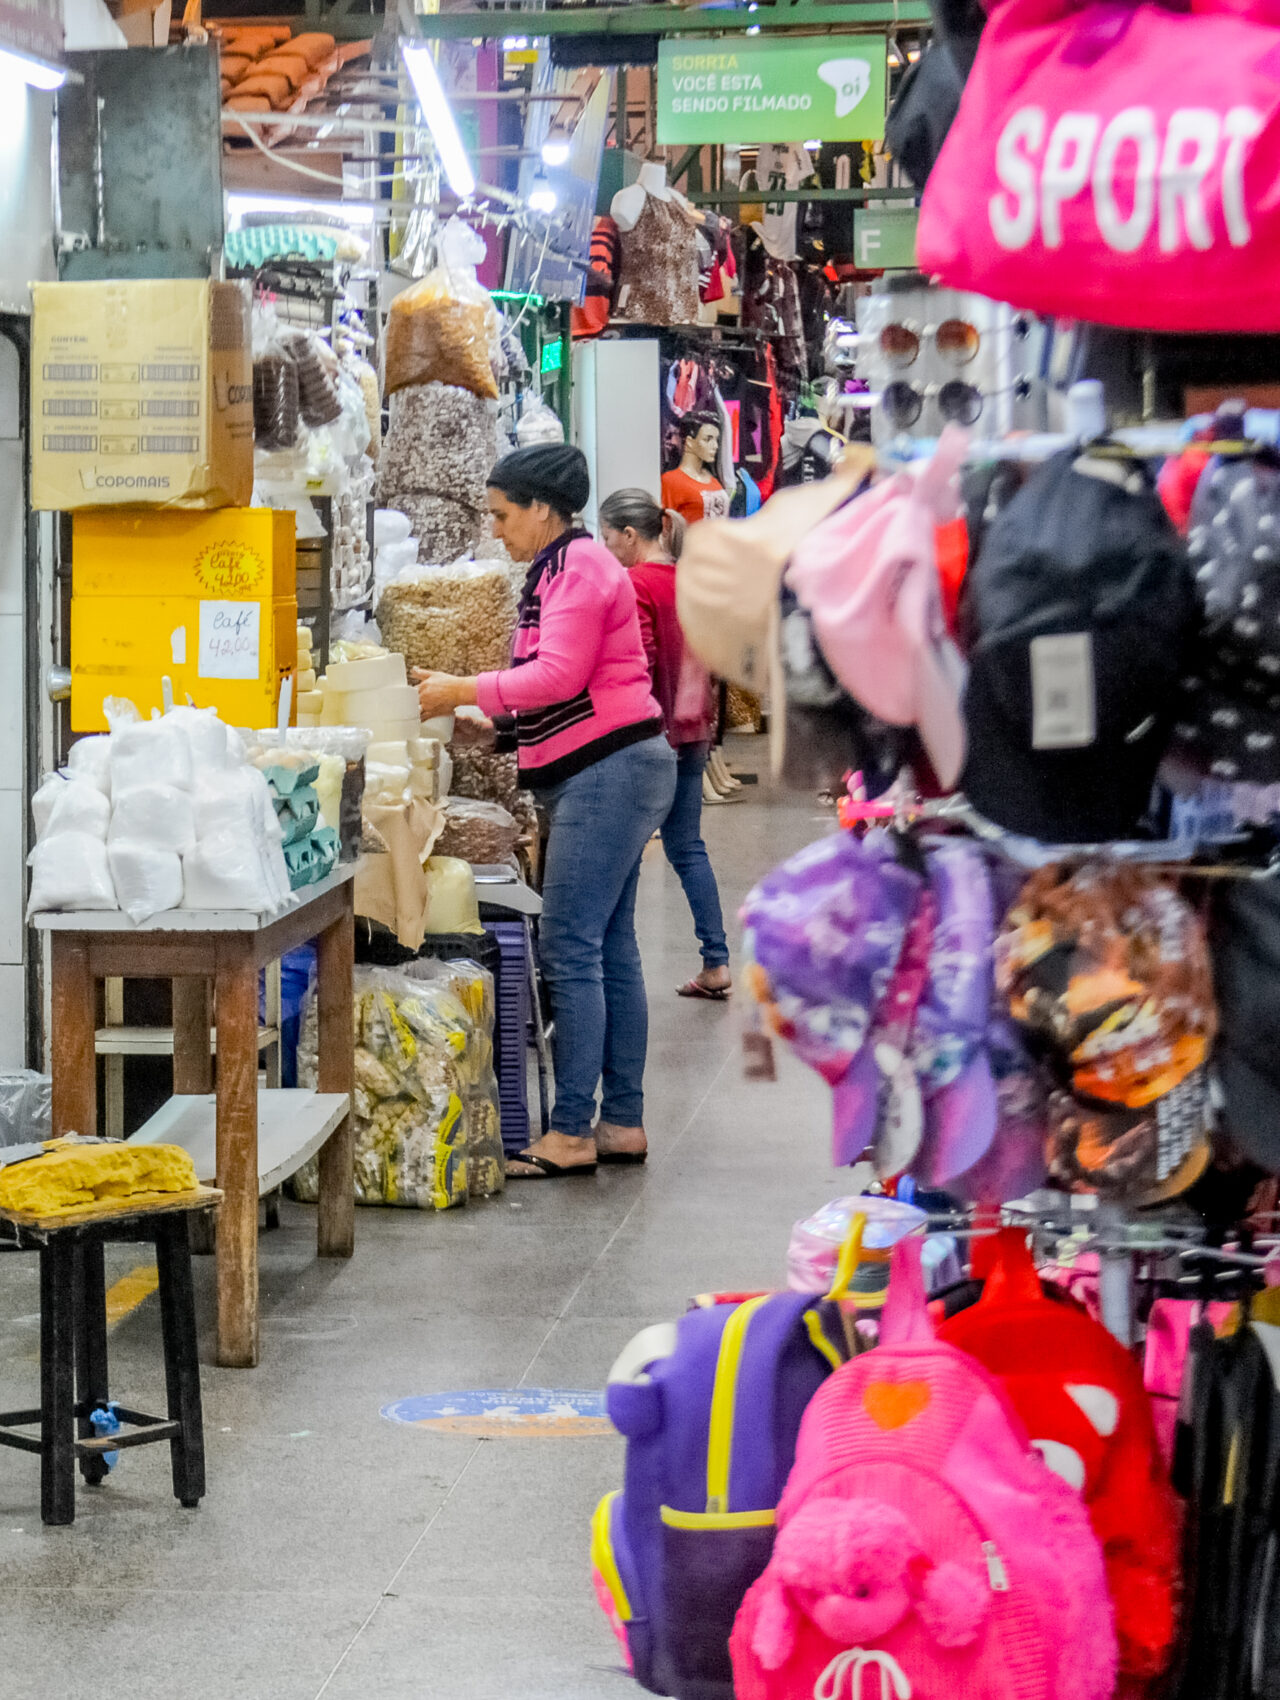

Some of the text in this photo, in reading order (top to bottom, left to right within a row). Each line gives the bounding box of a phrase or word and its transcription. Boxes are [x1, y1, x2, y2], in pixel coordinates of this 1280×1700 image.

[672, 55, 738, 71] SORRIA
[671, 74, 716, 92] VOCÊ
[671, 95, 812, 113] SENDO FILMADO
[988, 105, 1260, 253] SPORT
[861, 230, 881, 262] F
[96, 476, 170, 488] COPOMAIS
[213, 610, 253, 635] Café
